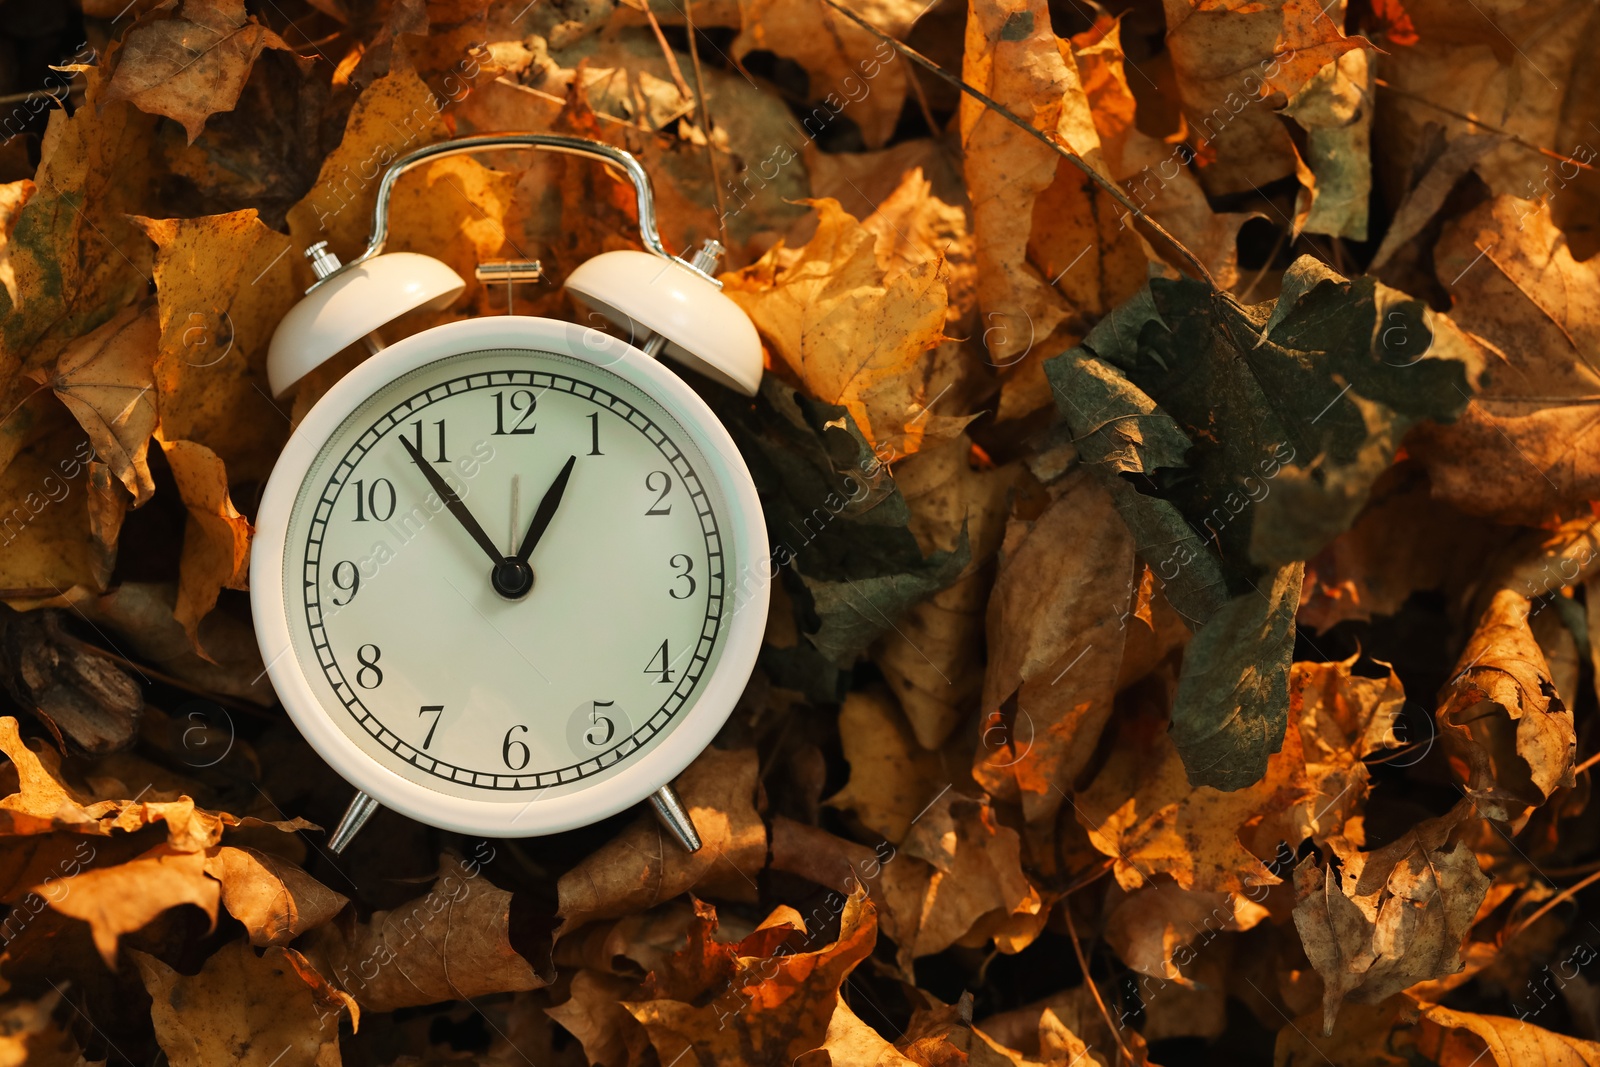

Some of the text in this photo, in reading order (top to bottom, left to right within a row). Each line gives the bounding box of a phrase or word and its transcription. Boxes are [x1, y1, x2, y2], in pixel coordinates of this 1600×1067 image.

[490, 389, 537, 436] 12
[585, 411, 605, 456] 1
[409, 418, 453, 464] 11
[350, 478, 397, 522] 10
[644, 470, 672, 516] 2
[331, 560, 360, 607] 9
[668, 553, 697, 600] 3
[355, 643, 384, 690] 8
[643, 638, 676, 684] 4
[418, 704, 445, 751] 7
[586, 700, 615, 746] 5
[502, 724, 531, 771] 6
